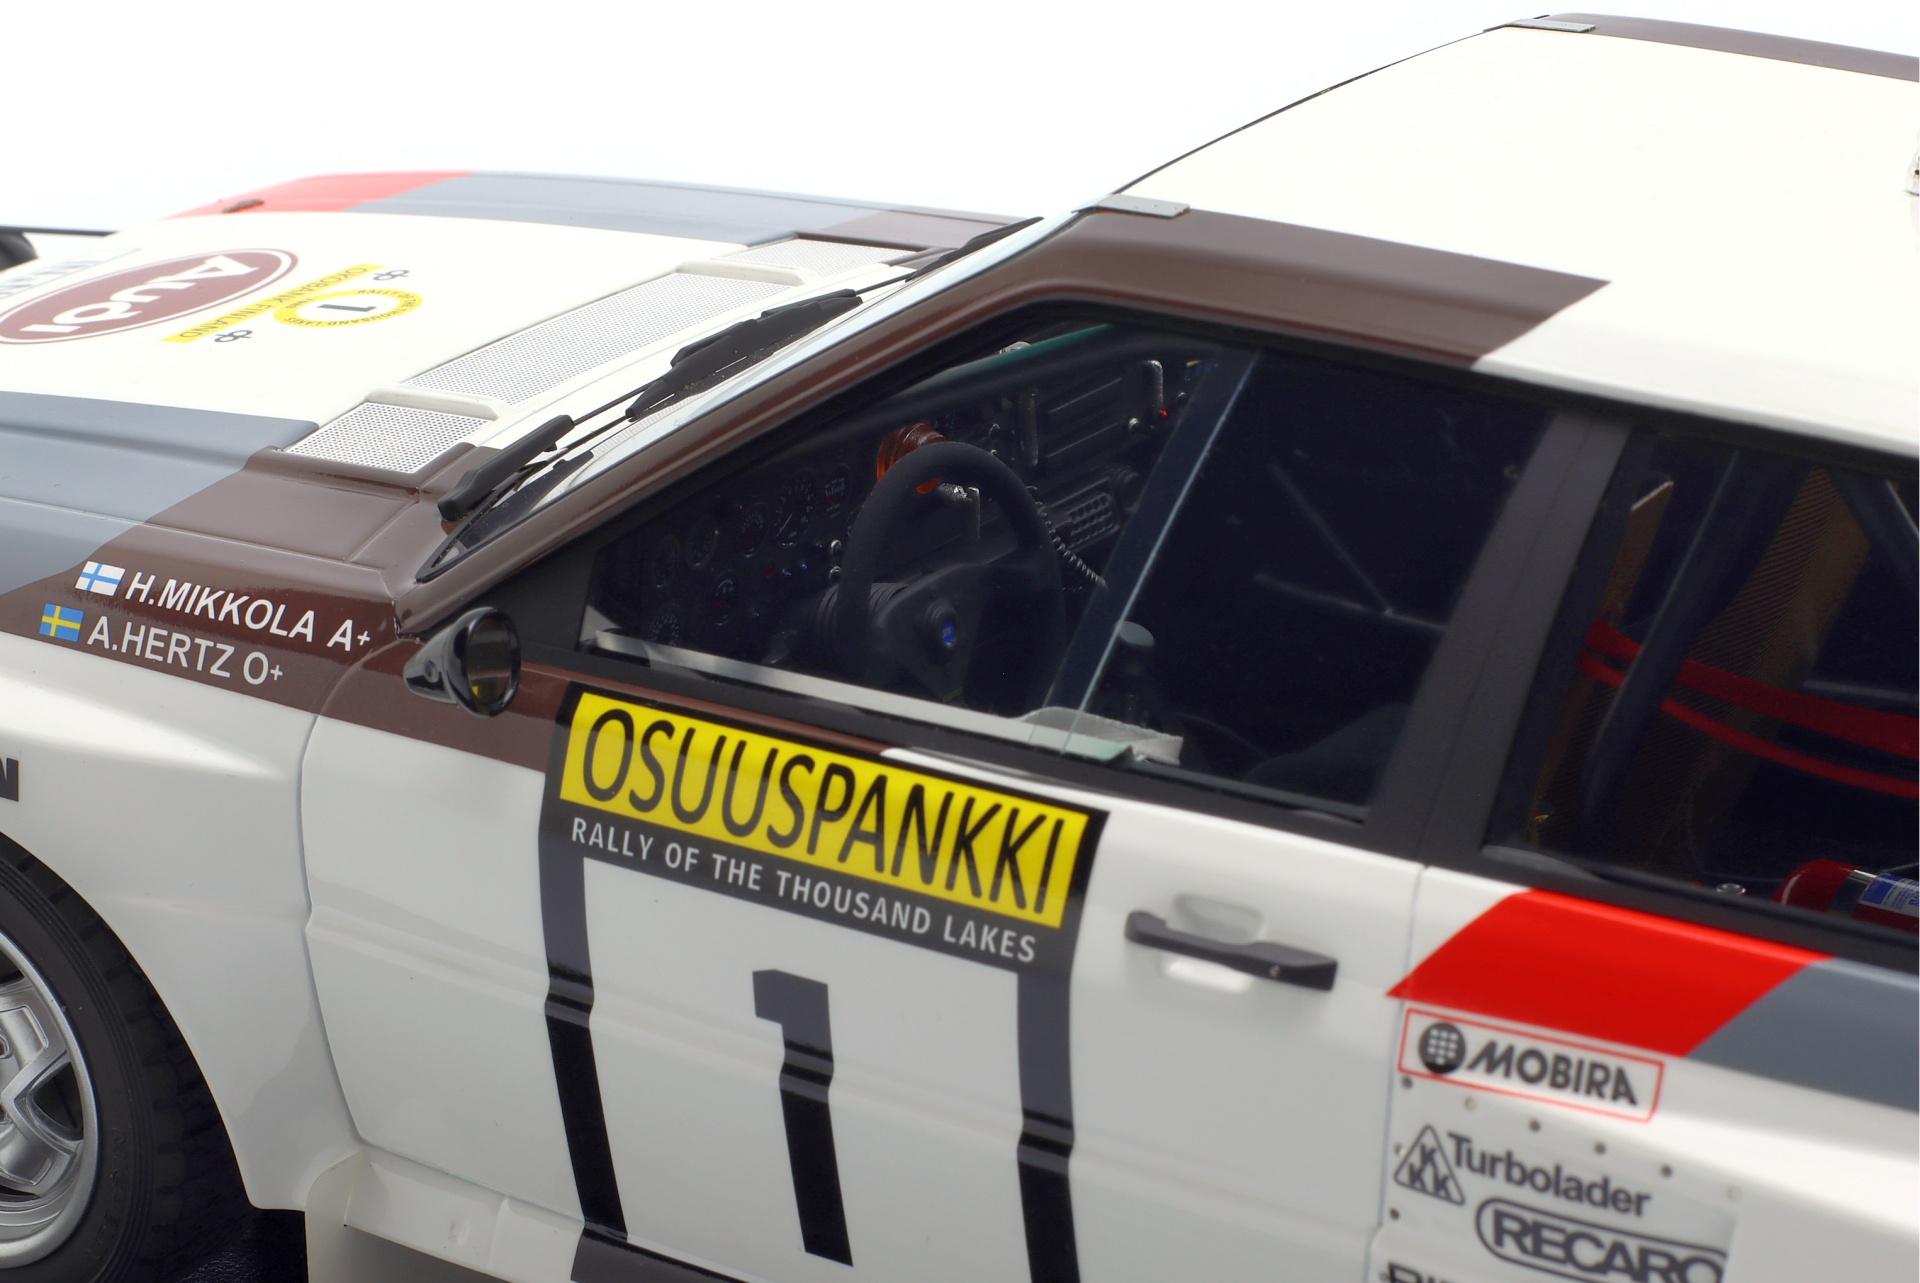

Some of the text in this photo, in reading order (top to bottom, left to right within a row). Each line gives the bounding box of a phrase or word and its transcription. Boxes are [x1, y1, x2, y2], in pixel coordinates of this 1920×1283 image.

[180, 303, 272, 338] FINLAND
[327, 308, 407, 326] THOUSAND
[87, 615, 284, 685] A.HERTZ O+
[125, 571, 371, 652] H.MIKKOLA A+
[582, 708, 1066, 915] OSUUSPANKKI
[571, 816, 1037, 963] RALLY OF THE THOUSAND LAKES
[1466, 1039, 1638, 1106] MOBIRA
[752, 968, 854, 1267] 1
[1447, 1131, 1651, 1217] Turbolader
[1492, 1208, 1725, 1283] RECARO
